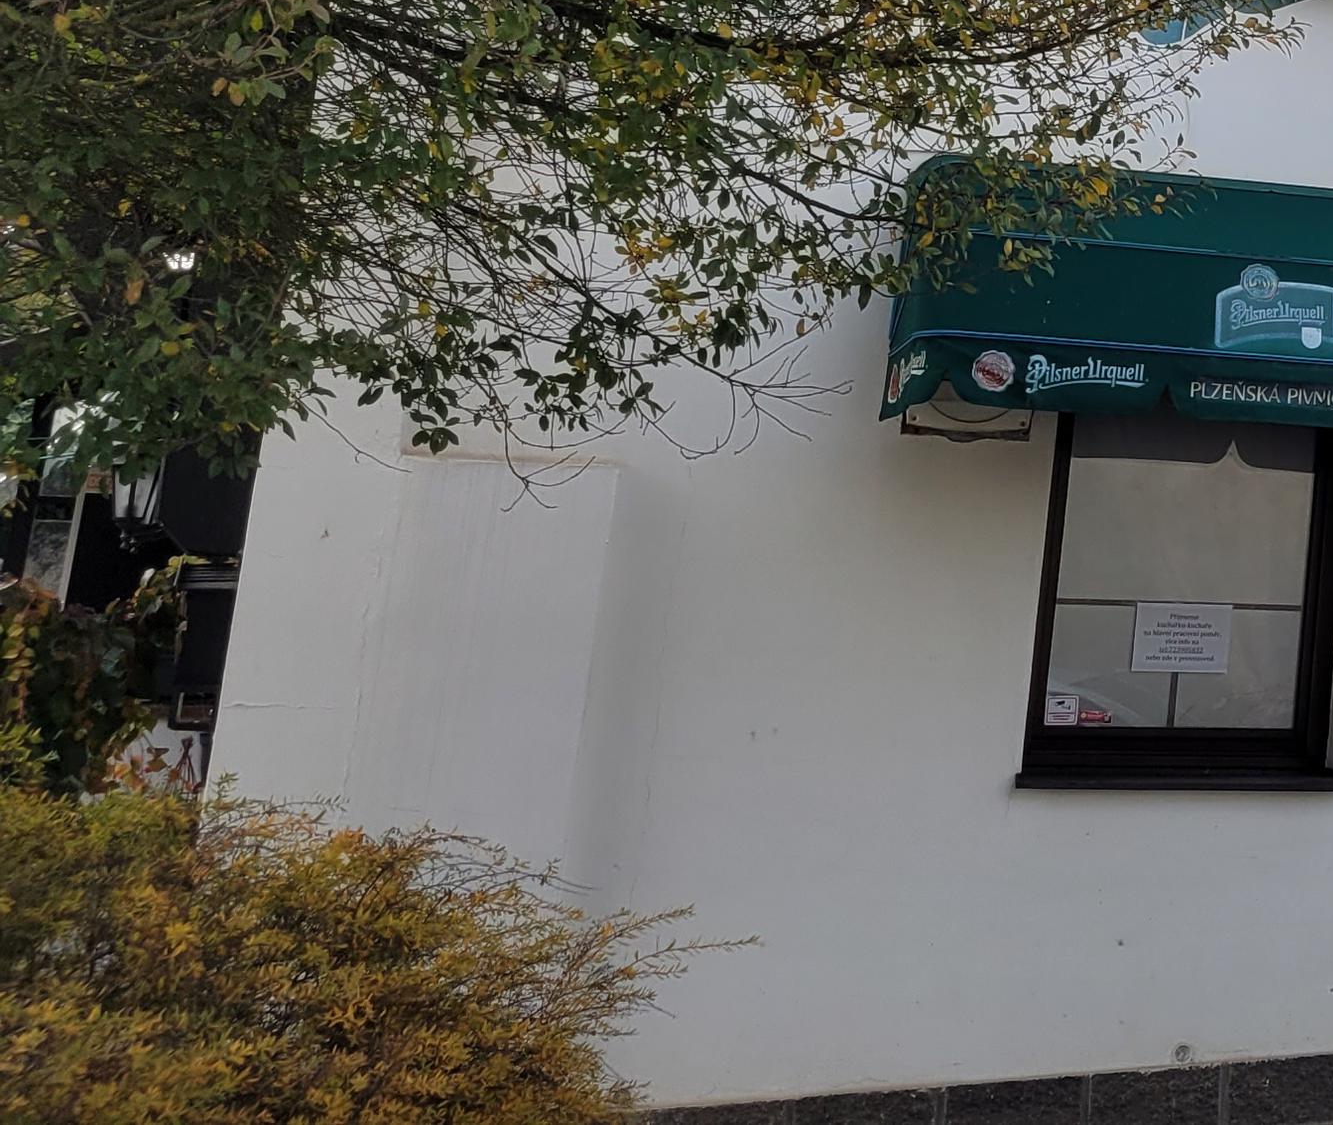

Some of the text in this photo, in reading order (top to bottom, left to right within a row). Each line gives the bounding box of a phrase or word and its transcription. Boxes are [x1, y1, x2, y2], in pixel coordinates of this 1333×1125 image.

[1230, 298, 1325, 330] Pilsner Urquell
[1024, 353, 1145, 394] Pilsner Urquell
[1189, 380, 1282, 404] PLZEŇSKÁ
